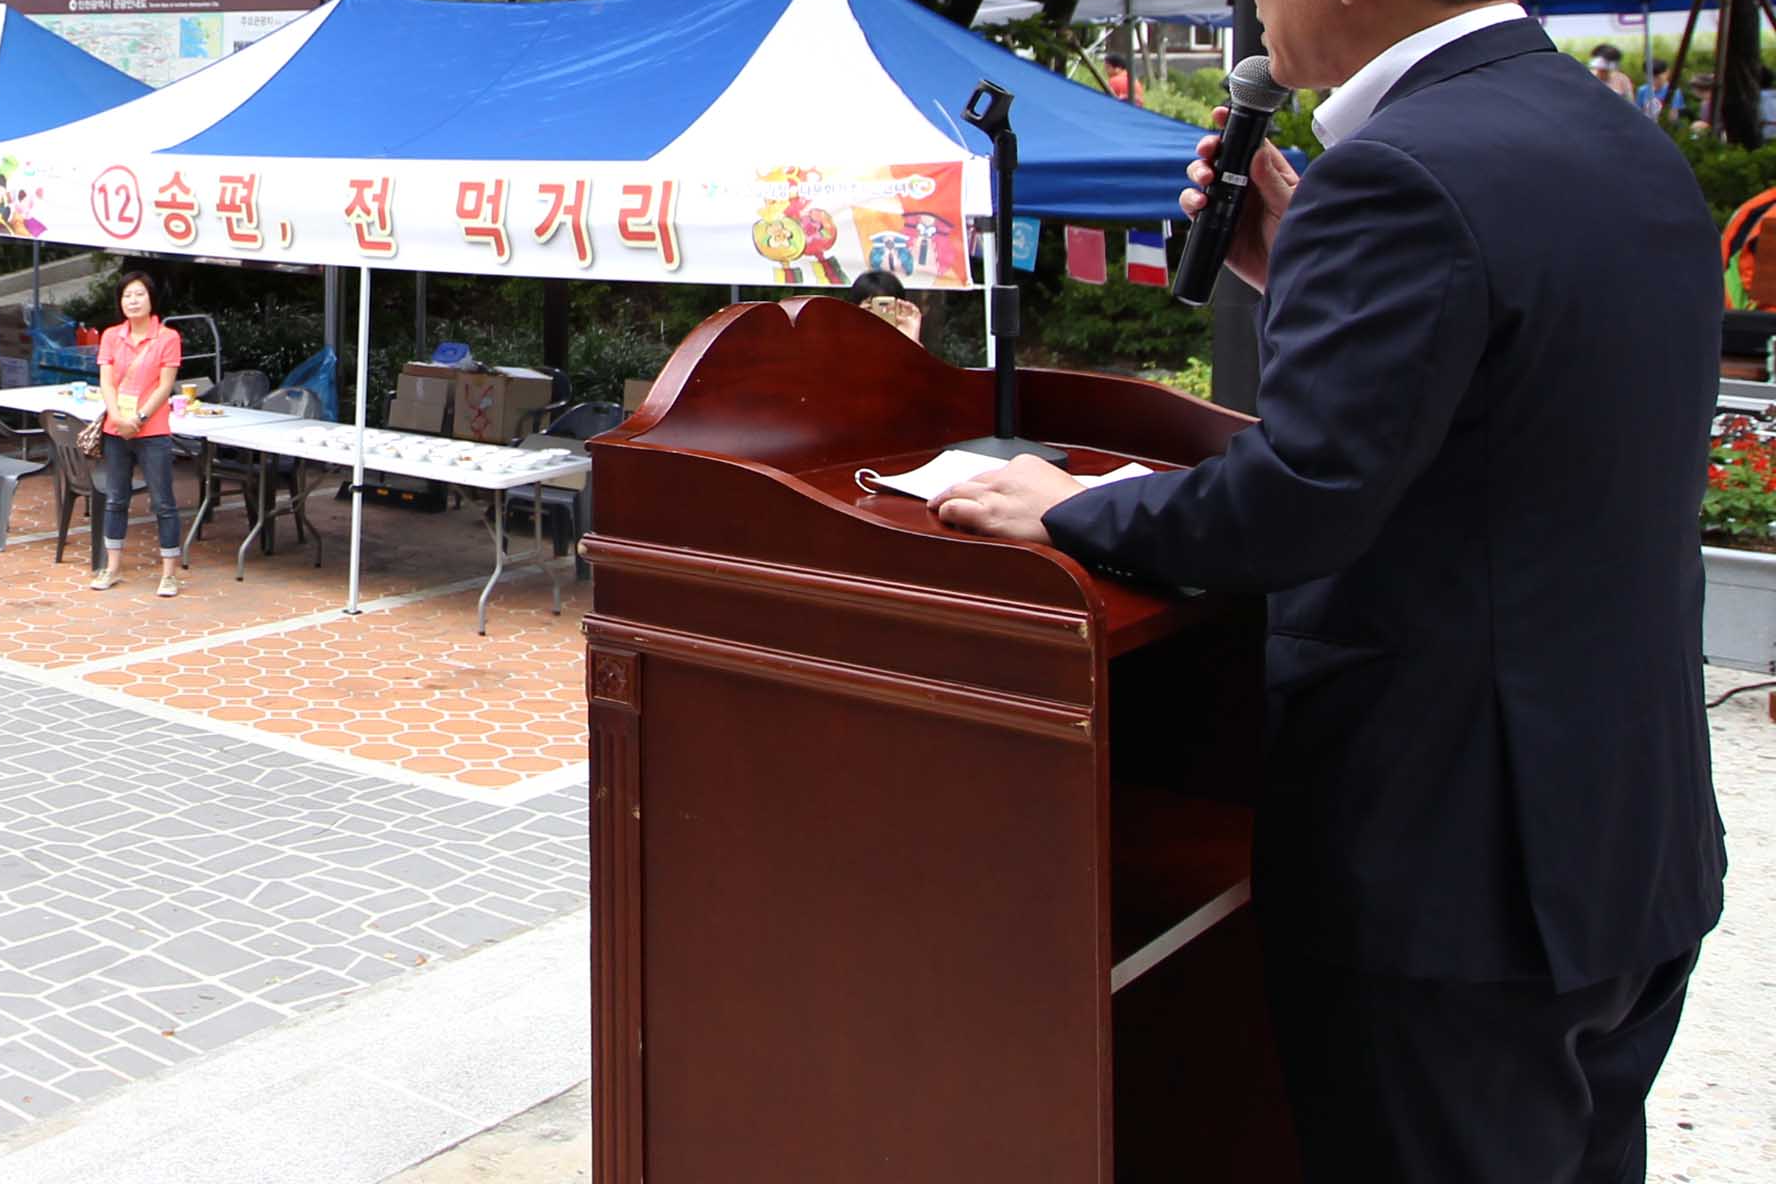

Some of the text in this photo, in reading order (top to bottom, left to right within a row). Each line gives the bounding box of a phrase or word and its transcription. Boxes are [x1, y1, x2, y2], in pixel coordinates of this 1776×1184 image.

[154, 171, 291, 245] 송편,
[344, 174, 397, 253] 전
[454, 179, 681, 264] 먹거리
